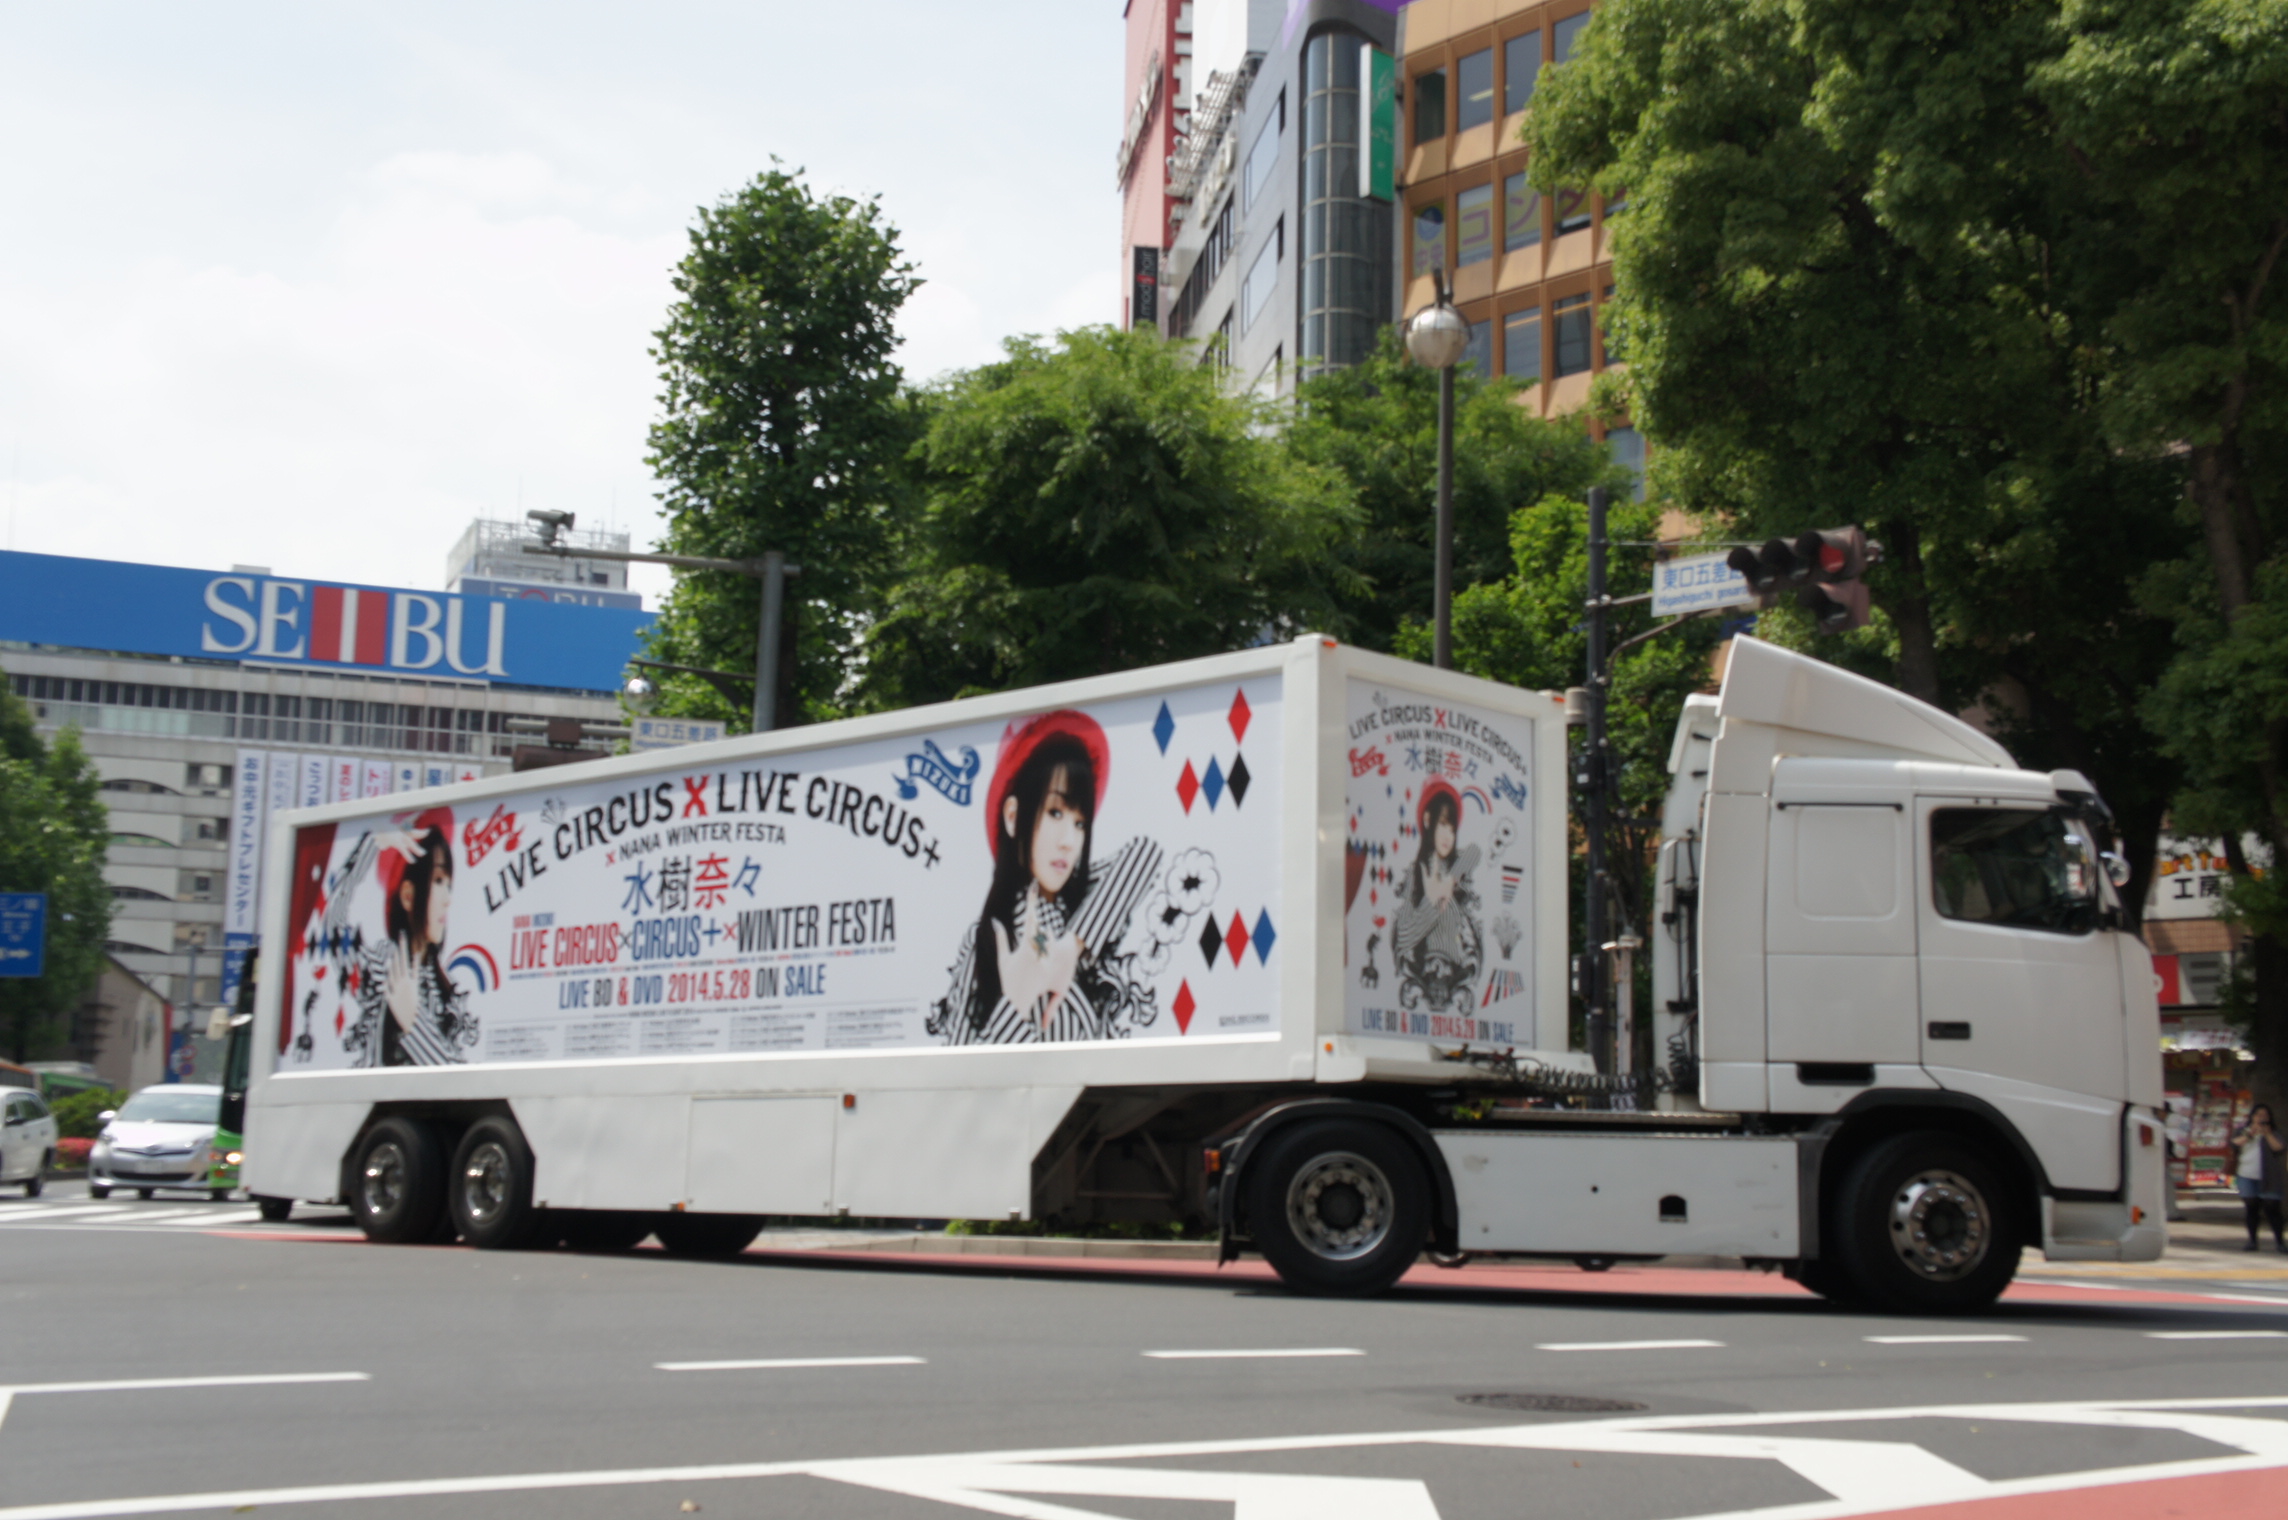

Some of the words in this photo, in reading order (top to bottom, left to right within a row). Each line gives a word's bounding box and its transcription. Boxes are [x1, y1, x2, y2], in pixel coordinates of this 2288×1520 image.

[202, 576, 510, 676] SEIBU
[1349, 712, 1379, 740] LIVE
[1380, 704, 1433, 727] CIRCUS
[1448, 710, 1480, 738] LIVE
[1394, 729, 1420, 742] NANA
[1423, 728, 1463, 748] WINTER
[1464, 740, 1494, 765] FESTA
[483, 837, 547, 914] LIVE
[554, 782, 674, 861] CIRCUS
[717, 770, 800, 814] LIVE
[619, 834, 661, 861] NANA
[666, 822, 732, 847] WINTER
[735, 822, 786, 845] FESTA
[621, 851, 762, 916] 水樹奈々
[510, 929, 548, 970] LIVE
[738, 904, 819, 953] WINTER
[828, 897, 895, 946] FESTA
[559, 979, 590, 1010] LIVE
[593, 978, 613, 1007] BD
[617, 976, 628, 1006] &
[633, 975, 663, 1005] DVD
[667, 969, 751, 1003] 2014.5.28
[756, 967, 779, 999] ON
[785, 964, 826, 997] SALE
[1362, 1007, 1383, 1031] LIVE
[1410, 1013, 1429, 1035] DVD
[1478, 1020, 1490, 1041] ON
[1493, 1021, 1514, 1044] SALE
